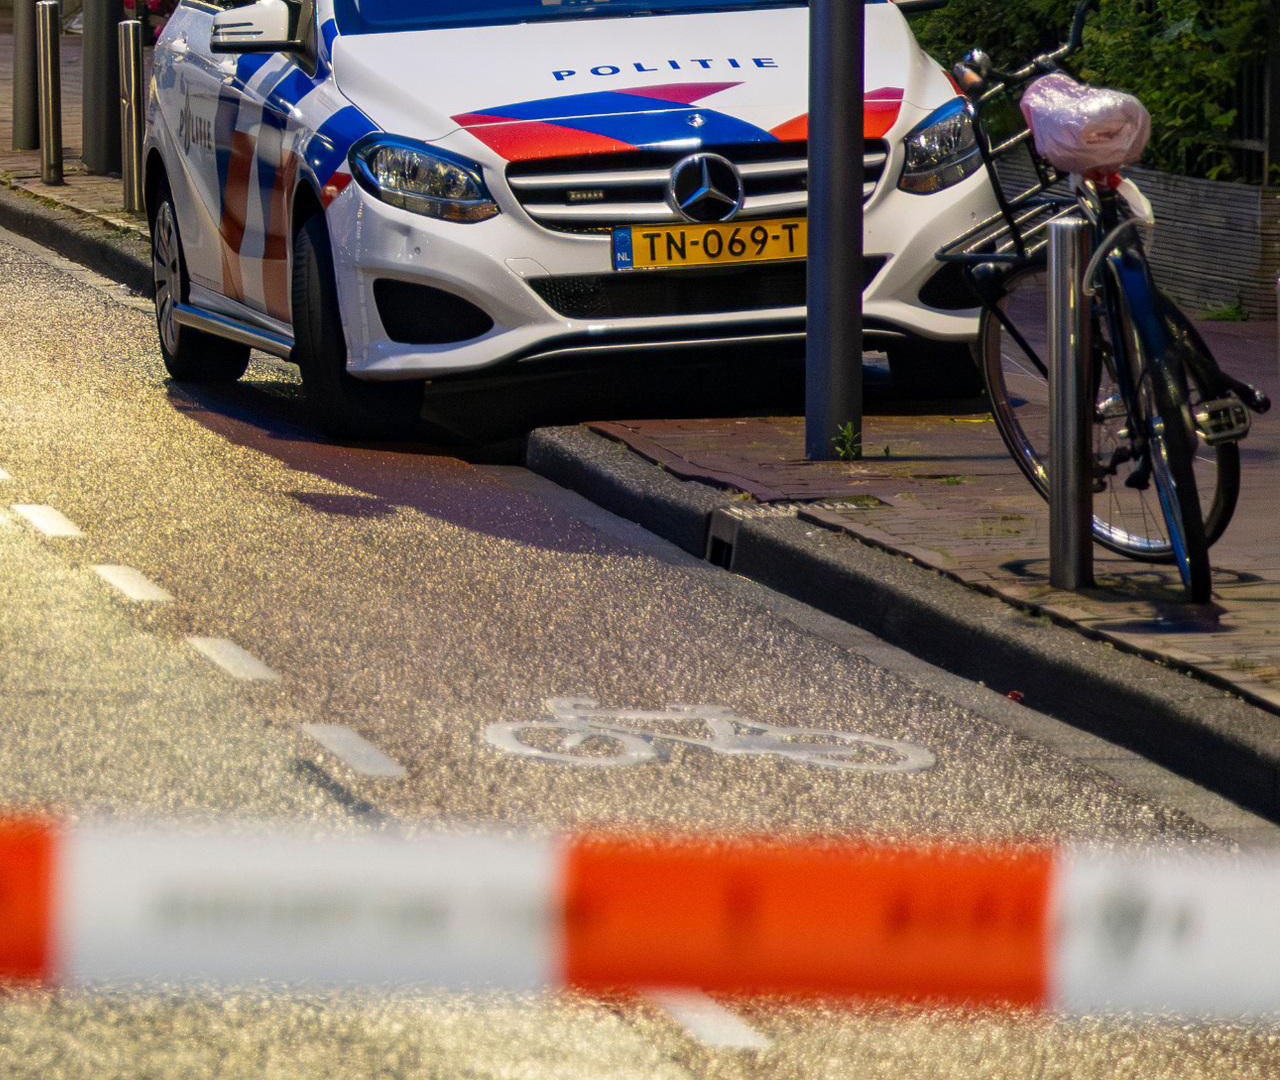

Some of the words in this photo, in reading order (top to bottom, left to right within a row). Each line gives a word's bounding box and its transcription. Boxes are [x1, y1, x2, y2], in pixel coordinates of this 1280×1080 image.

[551, 57, 779, 82] POLITIE
[616, 251, 631, 262] NL
[642, 223, 799, 262] TN-069-T
